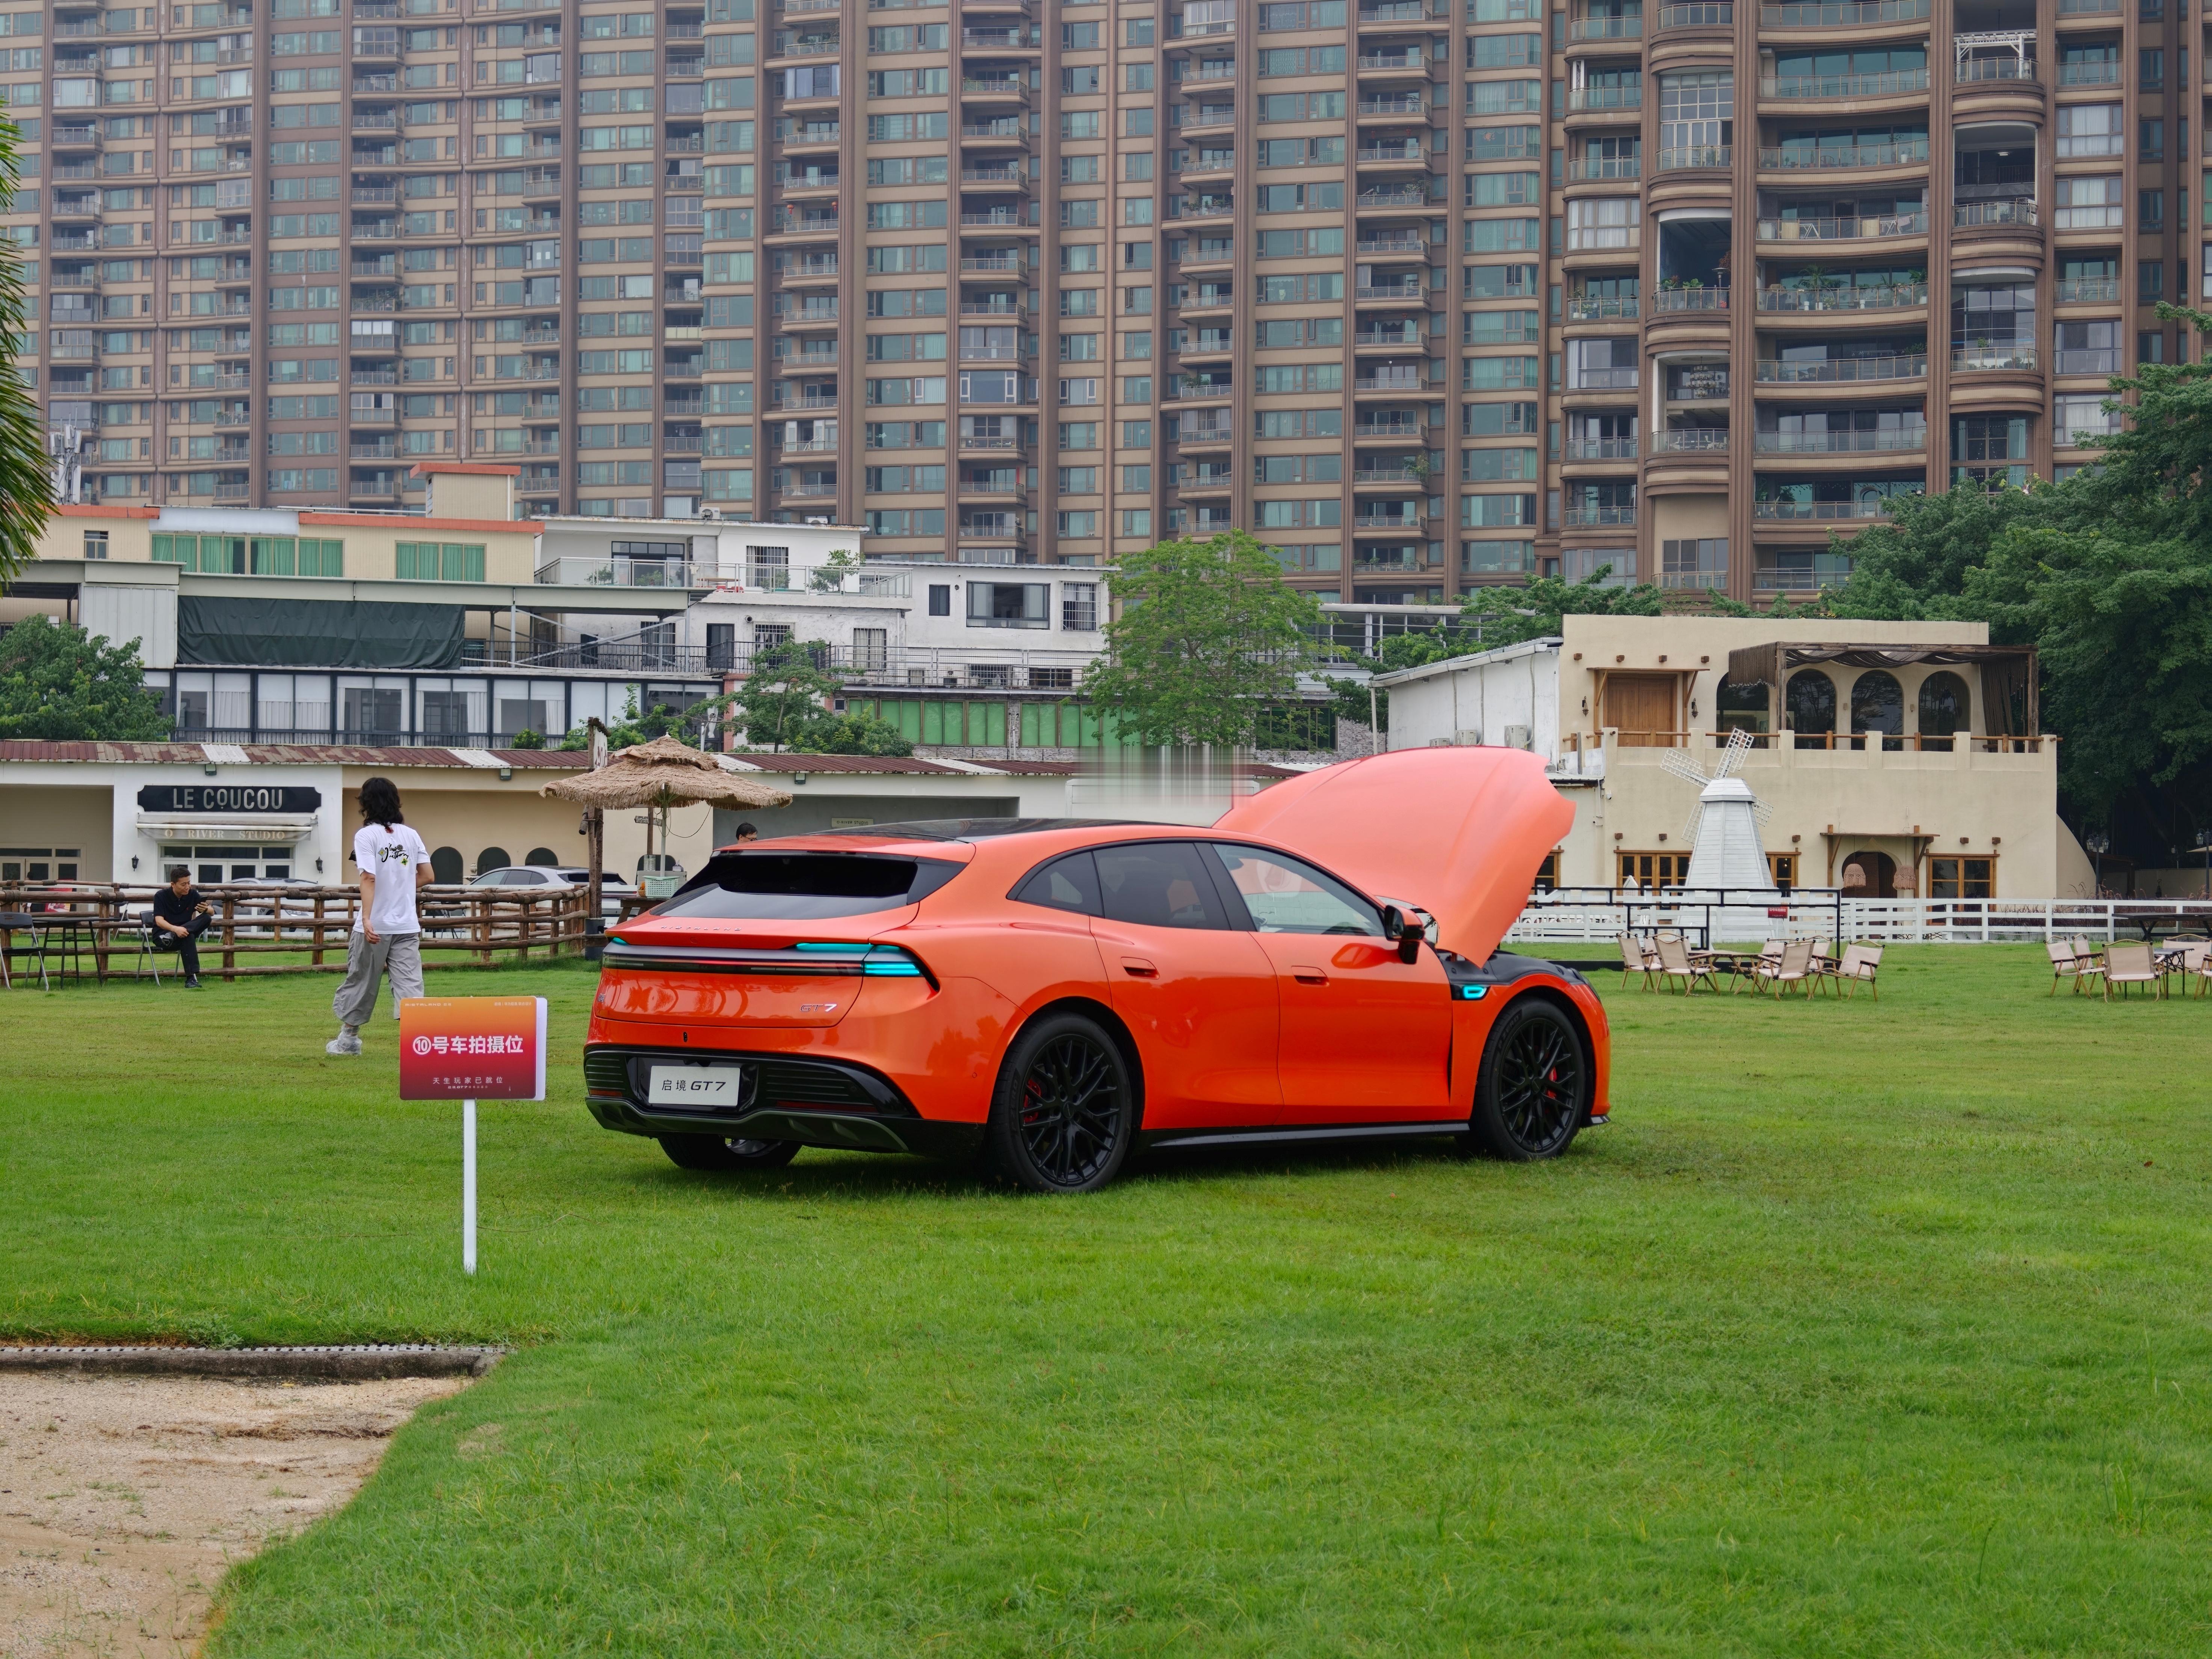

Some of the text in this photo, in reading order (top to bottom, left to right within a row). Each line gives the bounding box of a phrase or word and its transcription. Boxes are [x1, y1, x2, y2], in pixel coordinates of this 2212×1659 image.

[174, 788, 194, 808] LE
[165, 829, 285, 840] O RIVER STUDIO
[799, 1004, 837, 1012] GT7
[433, 1076, 503, 1085] 天生玩家已就位
[662, 1079, 726, 1091] 启境 GT7
